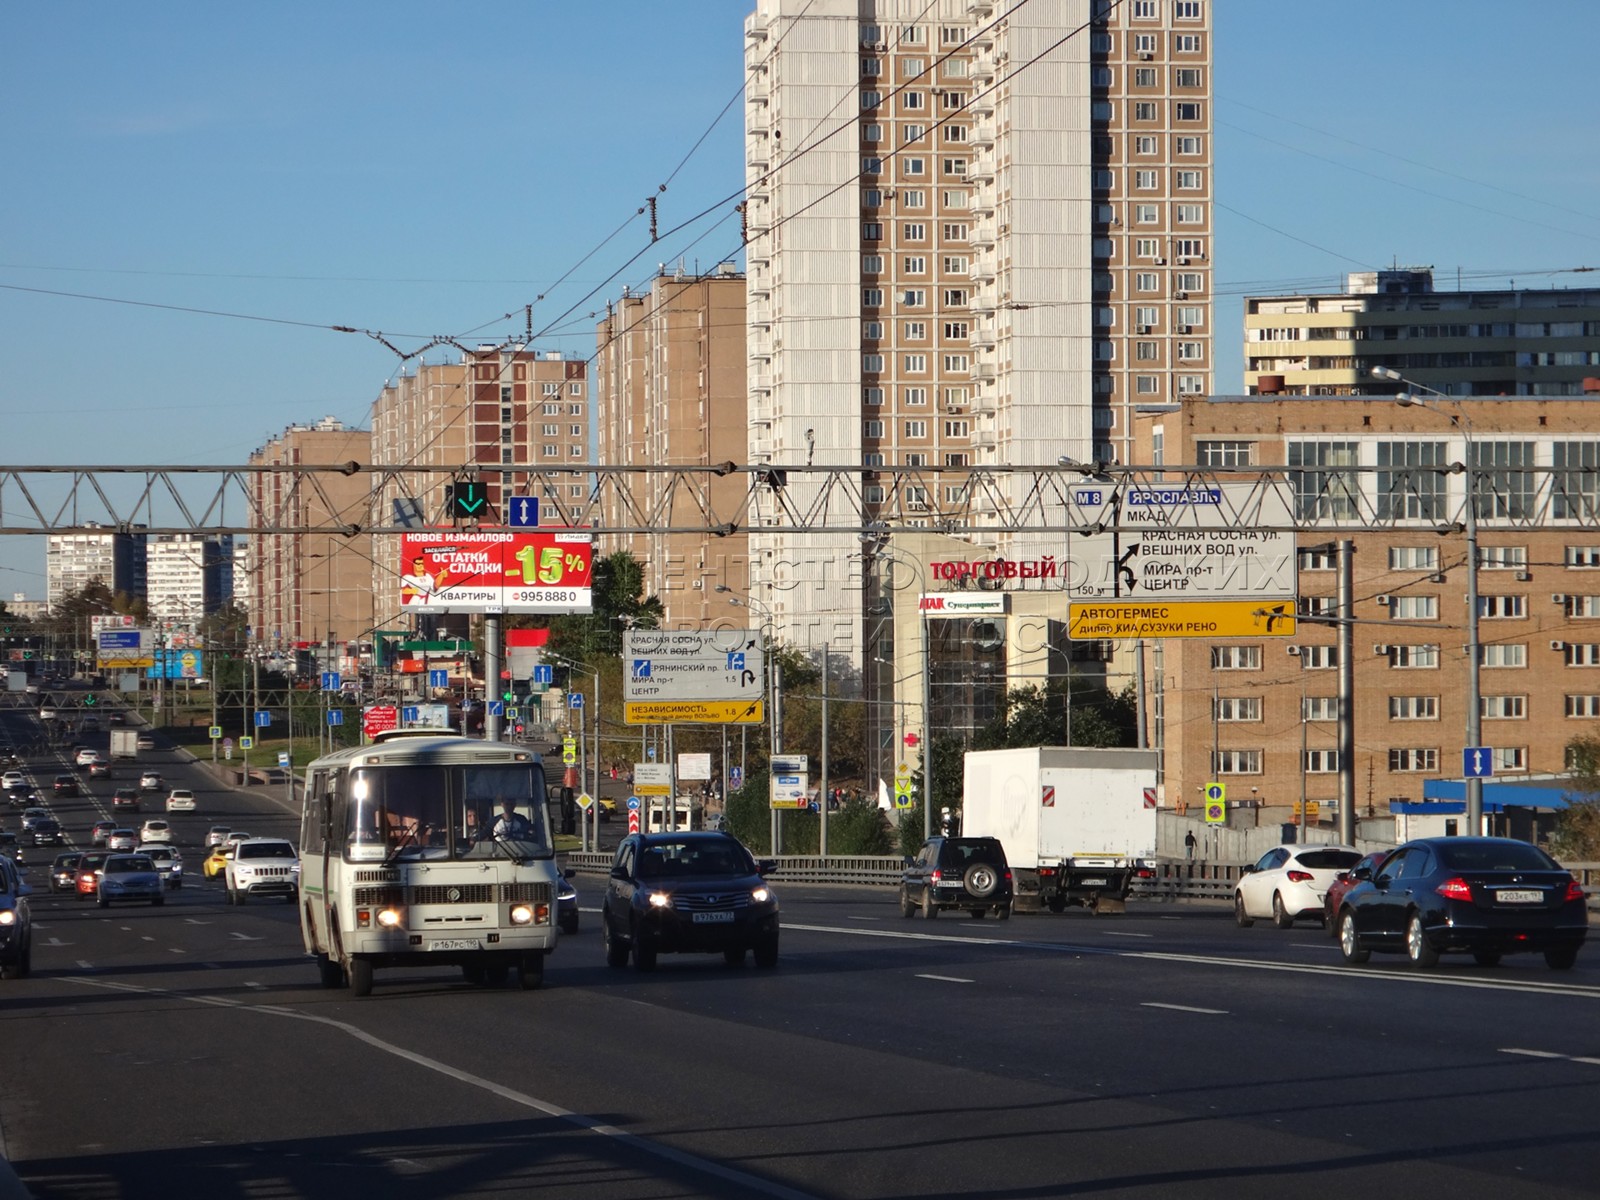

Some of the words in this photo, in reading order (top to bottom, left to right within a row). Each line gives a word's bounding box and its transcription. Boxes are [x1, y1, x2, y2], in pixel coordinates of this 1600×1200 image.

[1131, 491, 1218, 505] ЯРОСЛАВЛЬ
[1127, 511, 1166, 523] МКАД
[406, 533, 442, 542] НОВОЕ
[1142, 531, 1205, 541] КРАСНАЯ
[1210, 531, 1258, 540] СОСНА
[1262, 532, 1281, 542] ул.
[1142, 545, 1202, 555] ВЕШНИХ
[1206, 544, 1235, 557] ВОД
[1238, 547, 1258, 557] ул.
[432, 552, 488, 562] ОСТАТКИ
[450, 563, 502, 574] СЛАДКИ
[930, 556, 1057, 579] ТОРГОВЫЙ
[1144, 565, 1182, 575] МИРА
[1186, 567, 1213, 577] пр-т
[1144, 579, 1189, 591] ЦЕНТР
[440, 592, 496, 601] КВАРТИРЫ
[1077, 587, 1094, 595] 150
[1080, 608, 1169, 620] АВТОГЕРМЕС
[1079, 625, 1113, 635] дилер
[1116, 623, 1138, 633] КИА
[1141, 623, 1184, 633] СУЗУКИ
[1186, 622, 1217, 632] РЕНО
[631, 636, 670, 644] КРАСНАЯ
[673, 636, 701, 644] СОСНА
[631, 647, 668, 655] ВЕШНИХ
[670, 647, 688, 655] ВОД
[631, 705, 707, 713] НЕЗАВИСИМОСТЬ
